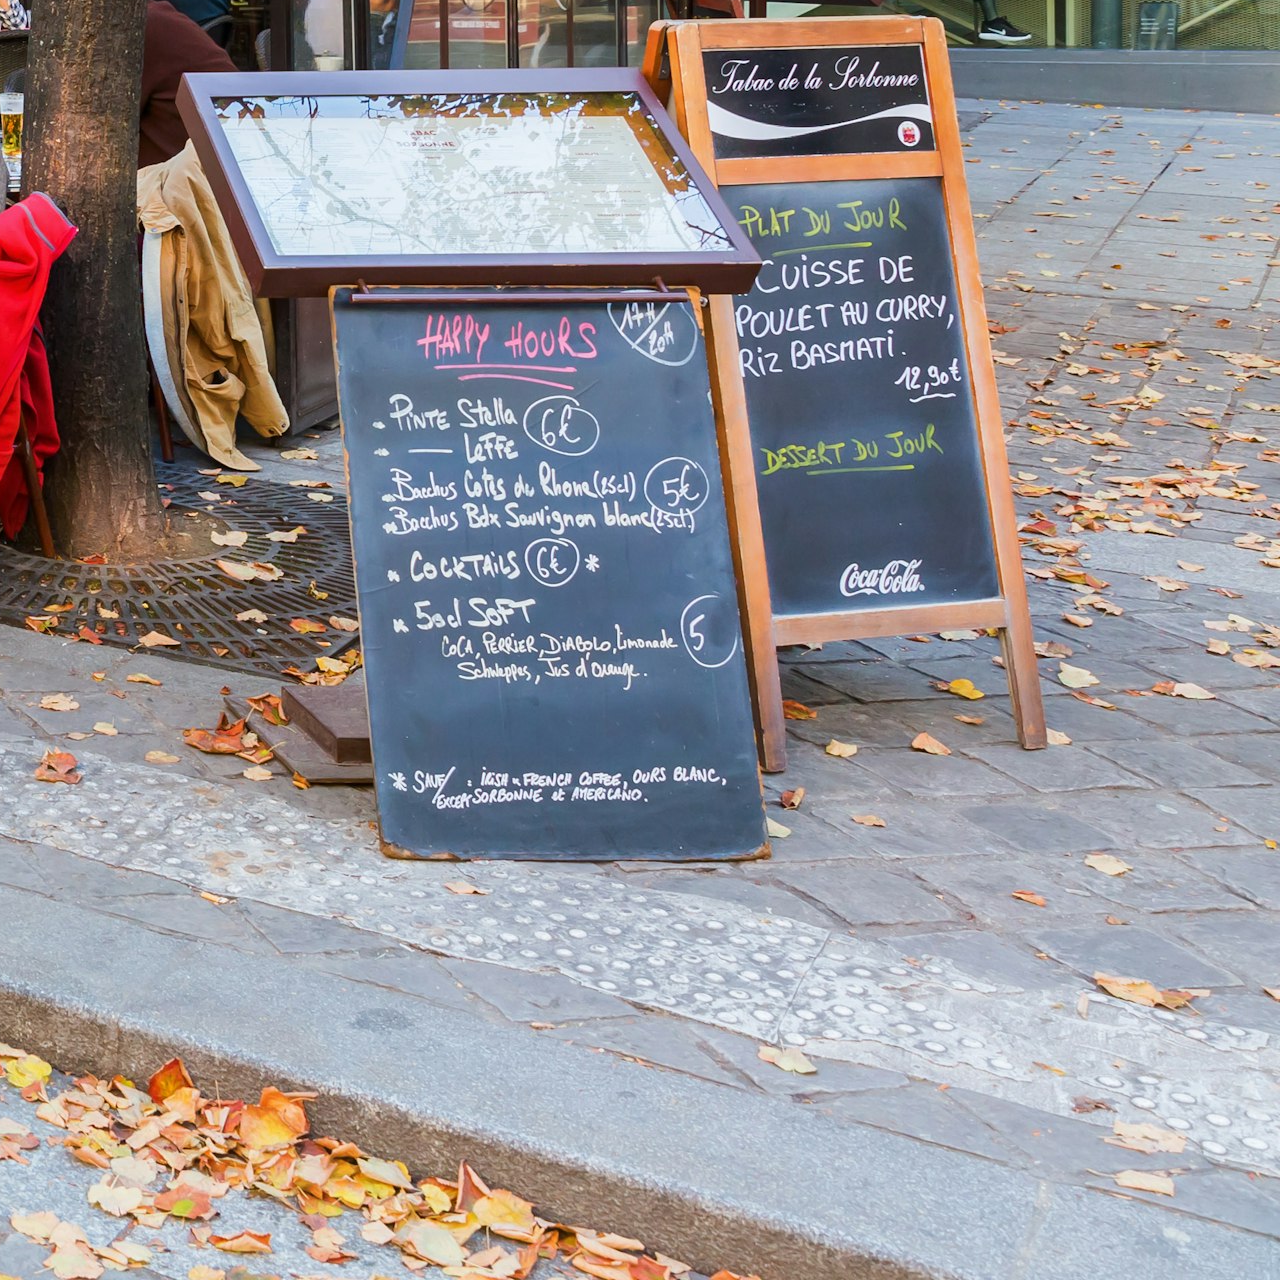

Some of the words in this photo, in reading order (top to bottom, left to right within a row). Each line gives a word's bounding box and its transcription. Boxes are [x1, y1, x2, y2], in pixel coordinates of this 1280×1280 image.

[712, 59, 775, 94] Tabac
[778, 63, 798, 90] de
[804, 62, 823, 90] la
[828, 55, 919, 91] Sorbonne
[738, 205, 796, 237] PLAT
[801, 207, 832, 237] DU
[836, 197, 908, 233] JOUR
[879, 256, 914, 284] DE
[735, 303, 835, 338] POULET
[840, 301, 868, 326] AU
[875, 294, 955, 330] CURRY,
[417, 314, 490, 363] HAPPY
[504, 316, 598, 360] HOURS
[894, 358, 962, 395] 12,90€
[457, 397, 518, 428] Stella
[541, 404, 581, 447] 6€
[760, 440, 845, 475] DESSERT
[851, 438, 878, 461] DU
[884, 423, 944, 458] JOUR
[389, 468, 458, 503] Bacchus
[514, 473, 536, 498] du
[662, 465, 700, 507] 5€
[389, 507, 459, 535] Bacchus
[462, 502, 501, 529] Bdx
[504, 502, 596, 536] Sauvignon
[536, 545, 567, 580] 6€
[537, 656, 570, 677] Jus
[522, 771, 572, 787] FRENCH
[633, 766, 667, 784] OURS
[673, 765, 727, 786] BLANC,
[436, 792, 472, 810] EXCEPT
[471, 788, 544, 805] SORBONNE
